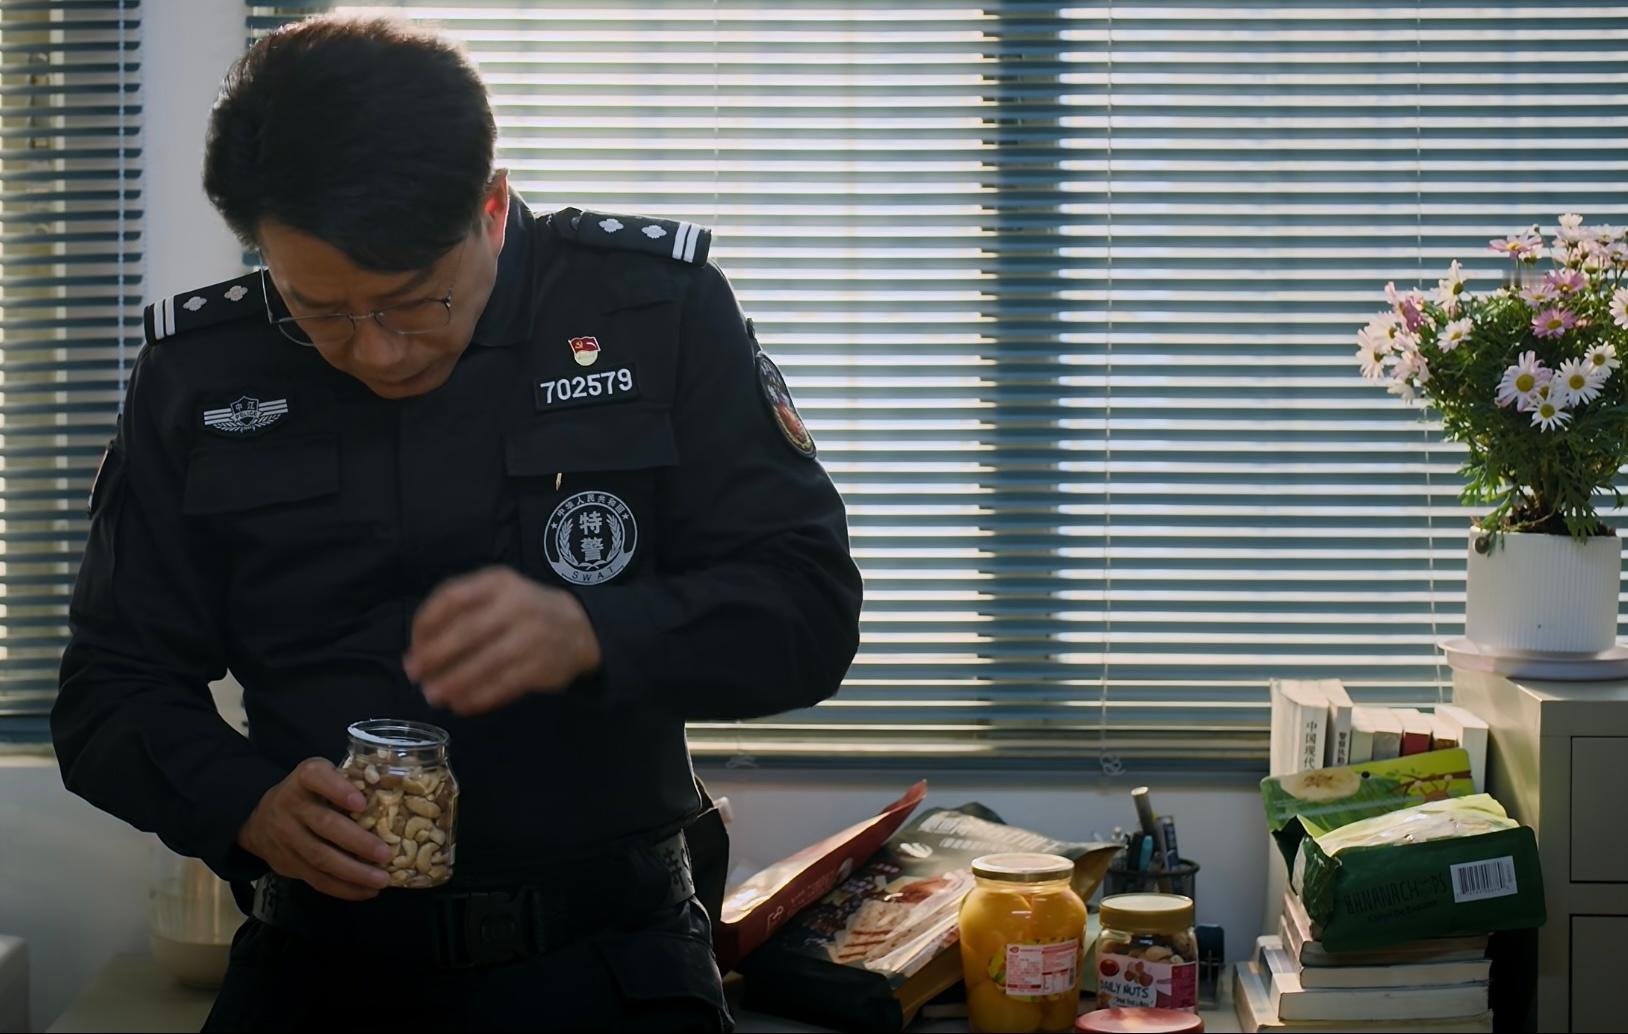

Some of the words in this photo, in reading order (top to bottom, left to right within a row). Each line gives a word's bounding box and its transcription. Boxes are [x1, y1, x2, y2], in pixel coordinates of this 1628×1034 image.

[540, 368, 633, 404] 702579
[579, 510, 604, 562] 特警
[572, 566, 614, 582] SWAT
[1123, 983, 1149, 999] NUTS
